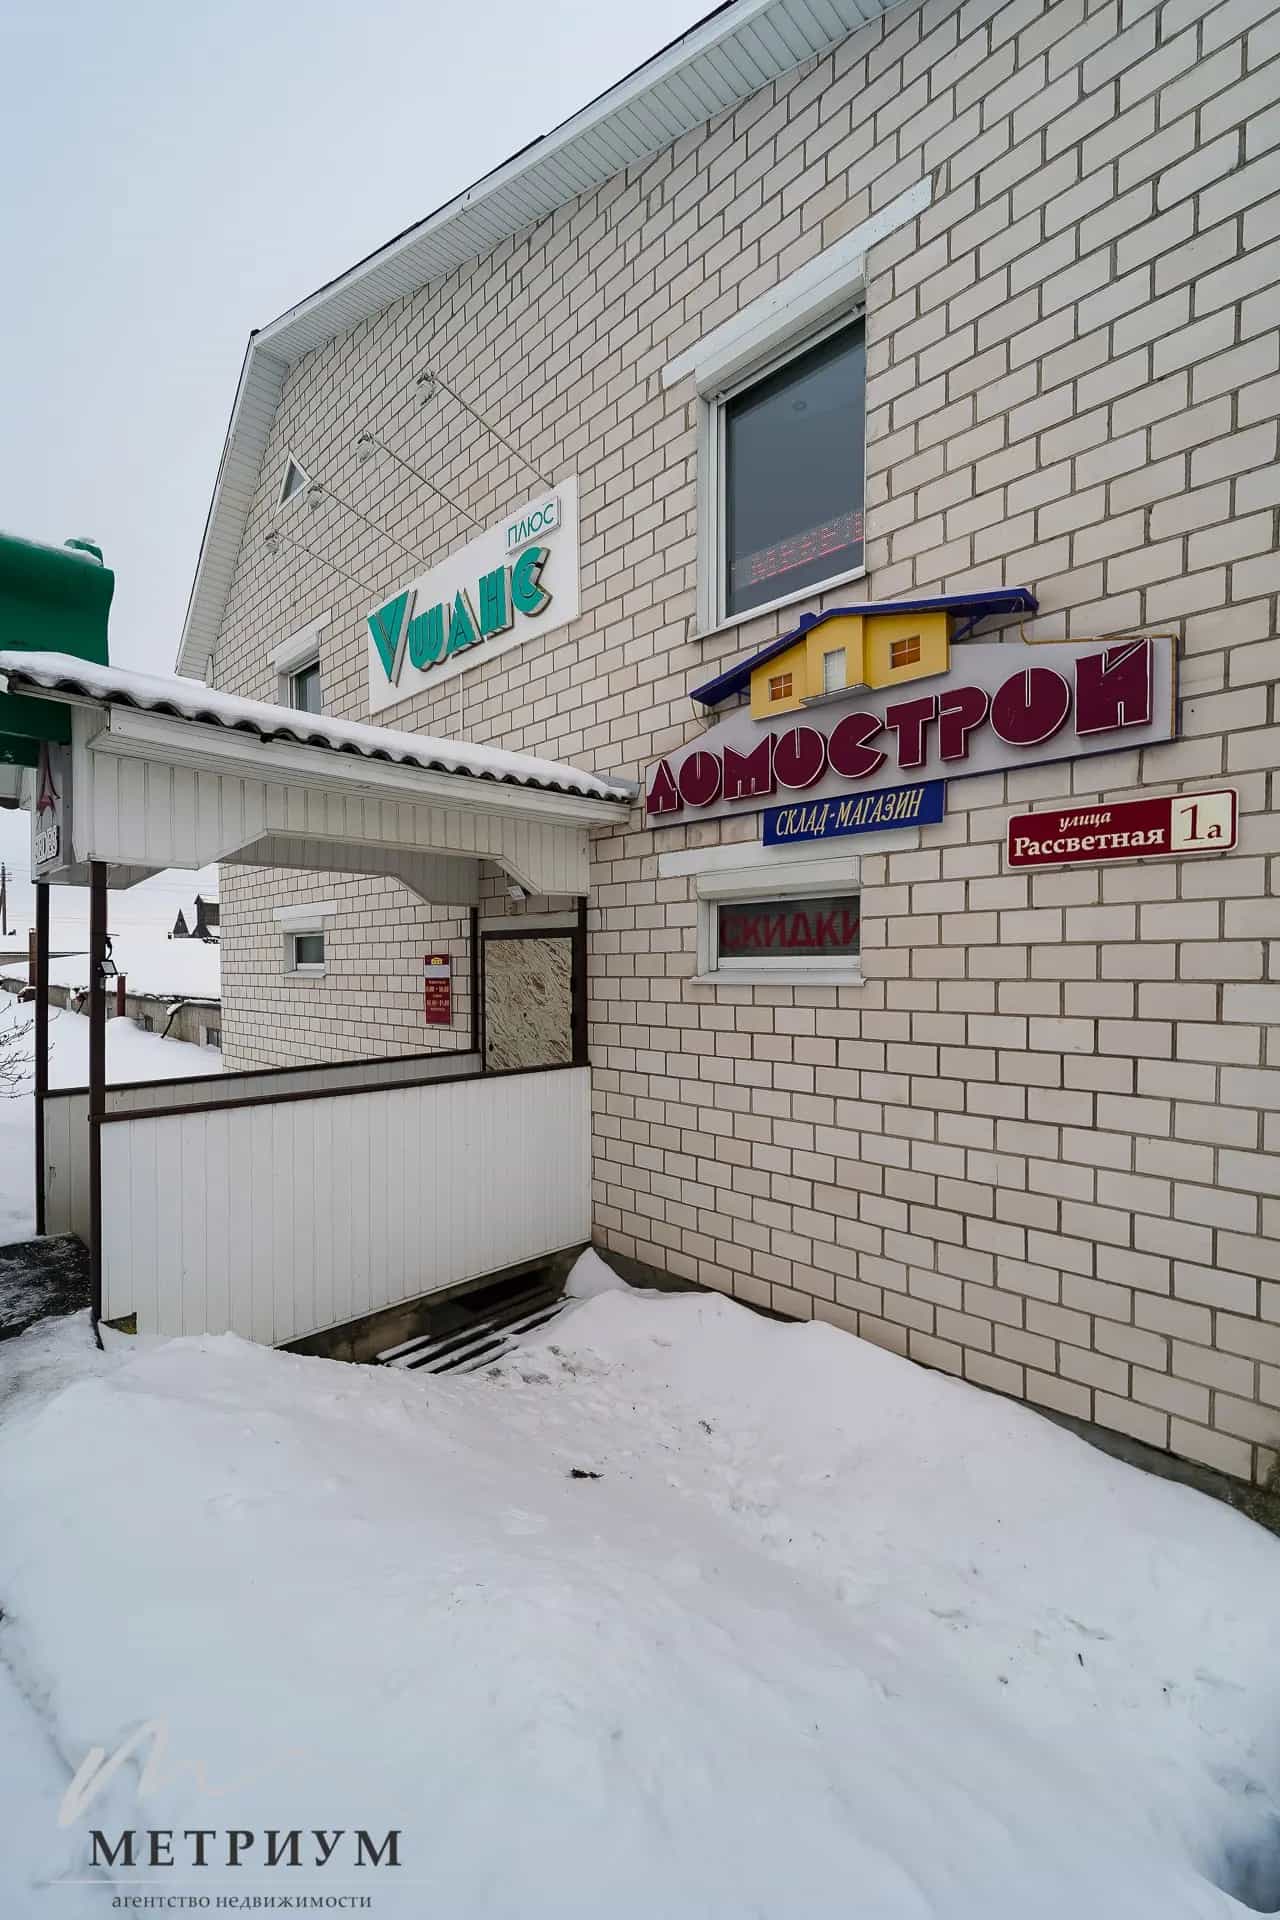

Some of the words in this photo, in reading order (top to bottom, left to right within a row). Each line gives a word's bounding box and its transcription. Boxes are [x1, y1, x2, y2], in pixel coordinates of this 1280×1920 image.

[507, 503, 555, 547] ПЛЮС
[645, 637, 1154, 817] ДОМОСТРОЙ
[775, 787, 926, 837] СКЛАД-МАГАЗИН
[1058, 811, 1113, 833] улица
[1179, 802, 1224, 843] 1а
[1013, 827, 1166, 858] Рассветная
